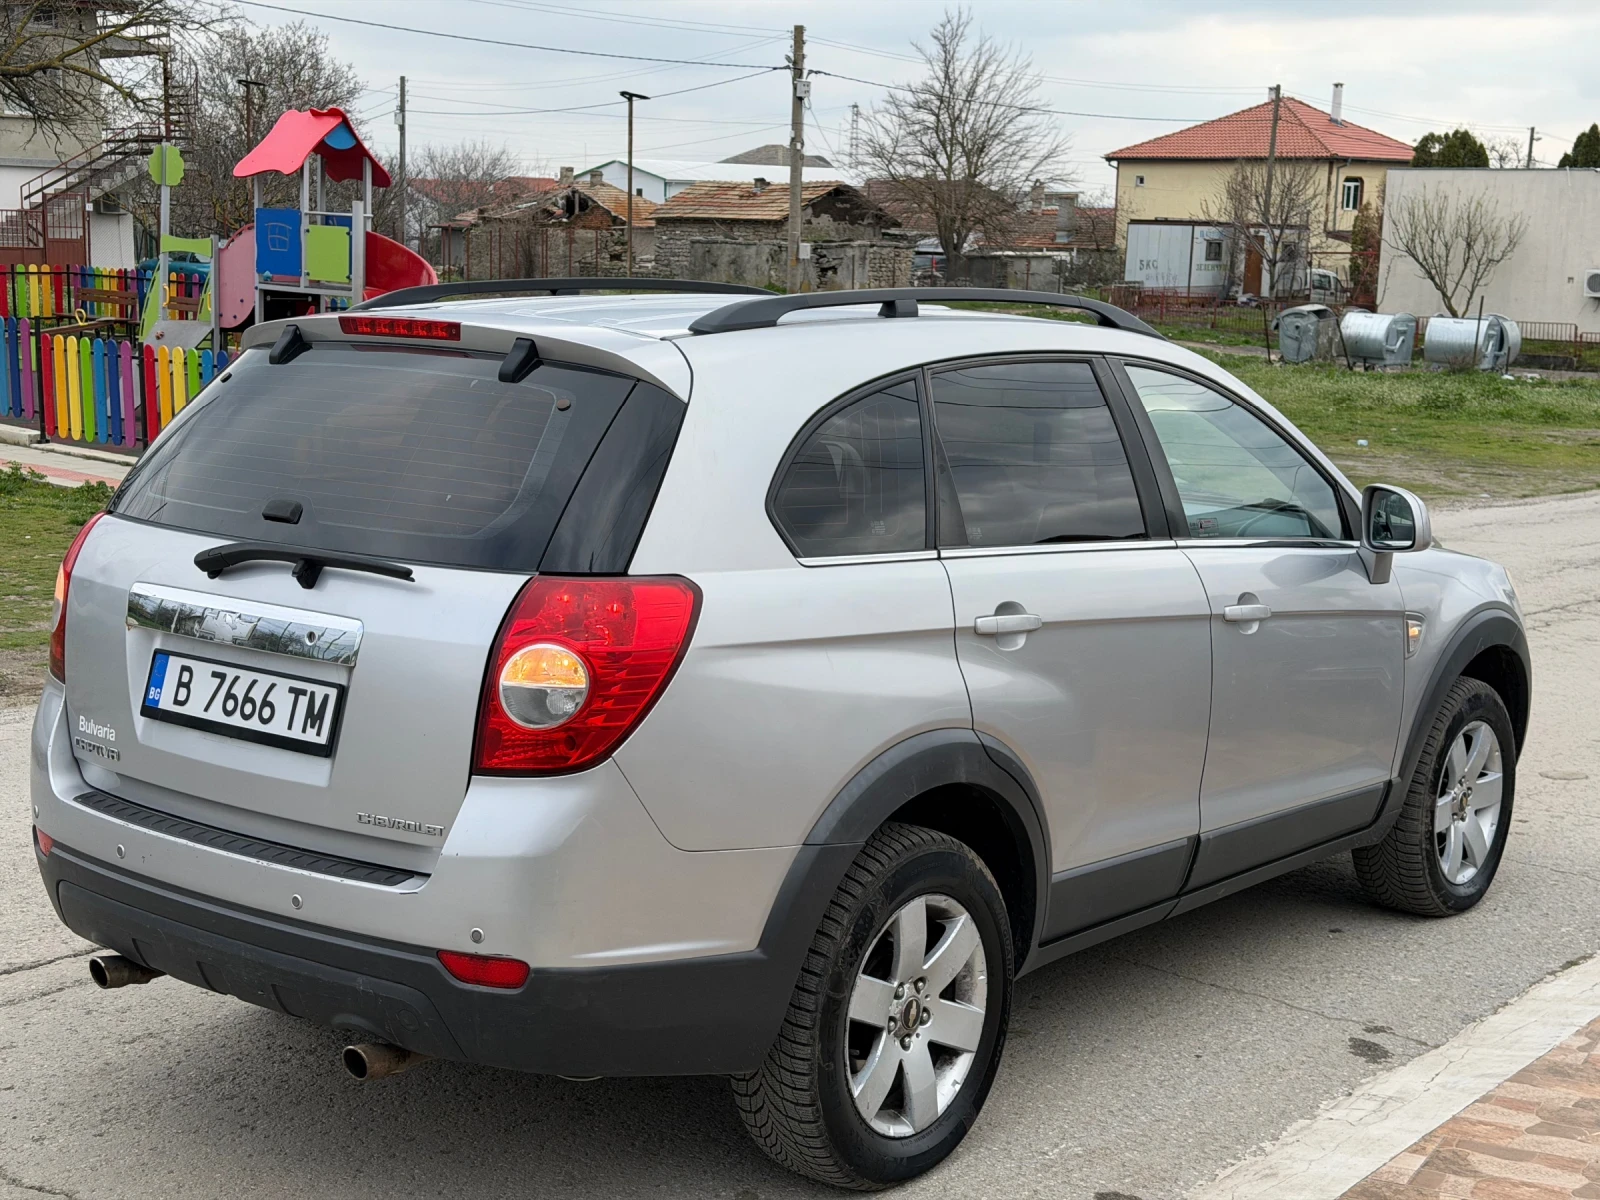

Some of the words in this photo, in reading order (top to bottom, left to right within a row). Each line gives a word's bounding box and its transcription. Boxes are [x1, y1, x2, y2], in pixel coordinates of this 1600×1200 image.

[148, 686, 161, 701] BG
[172, 664, 194, 707] B
[203, 670, 278, 726] 7666
[286, 685, 331, 737] TM
[79, 715, 116, 742] Bulvaria
[75, 736, 121, 762] CAPTIVA
[355, 811, 446, 837] CHEVROLET
